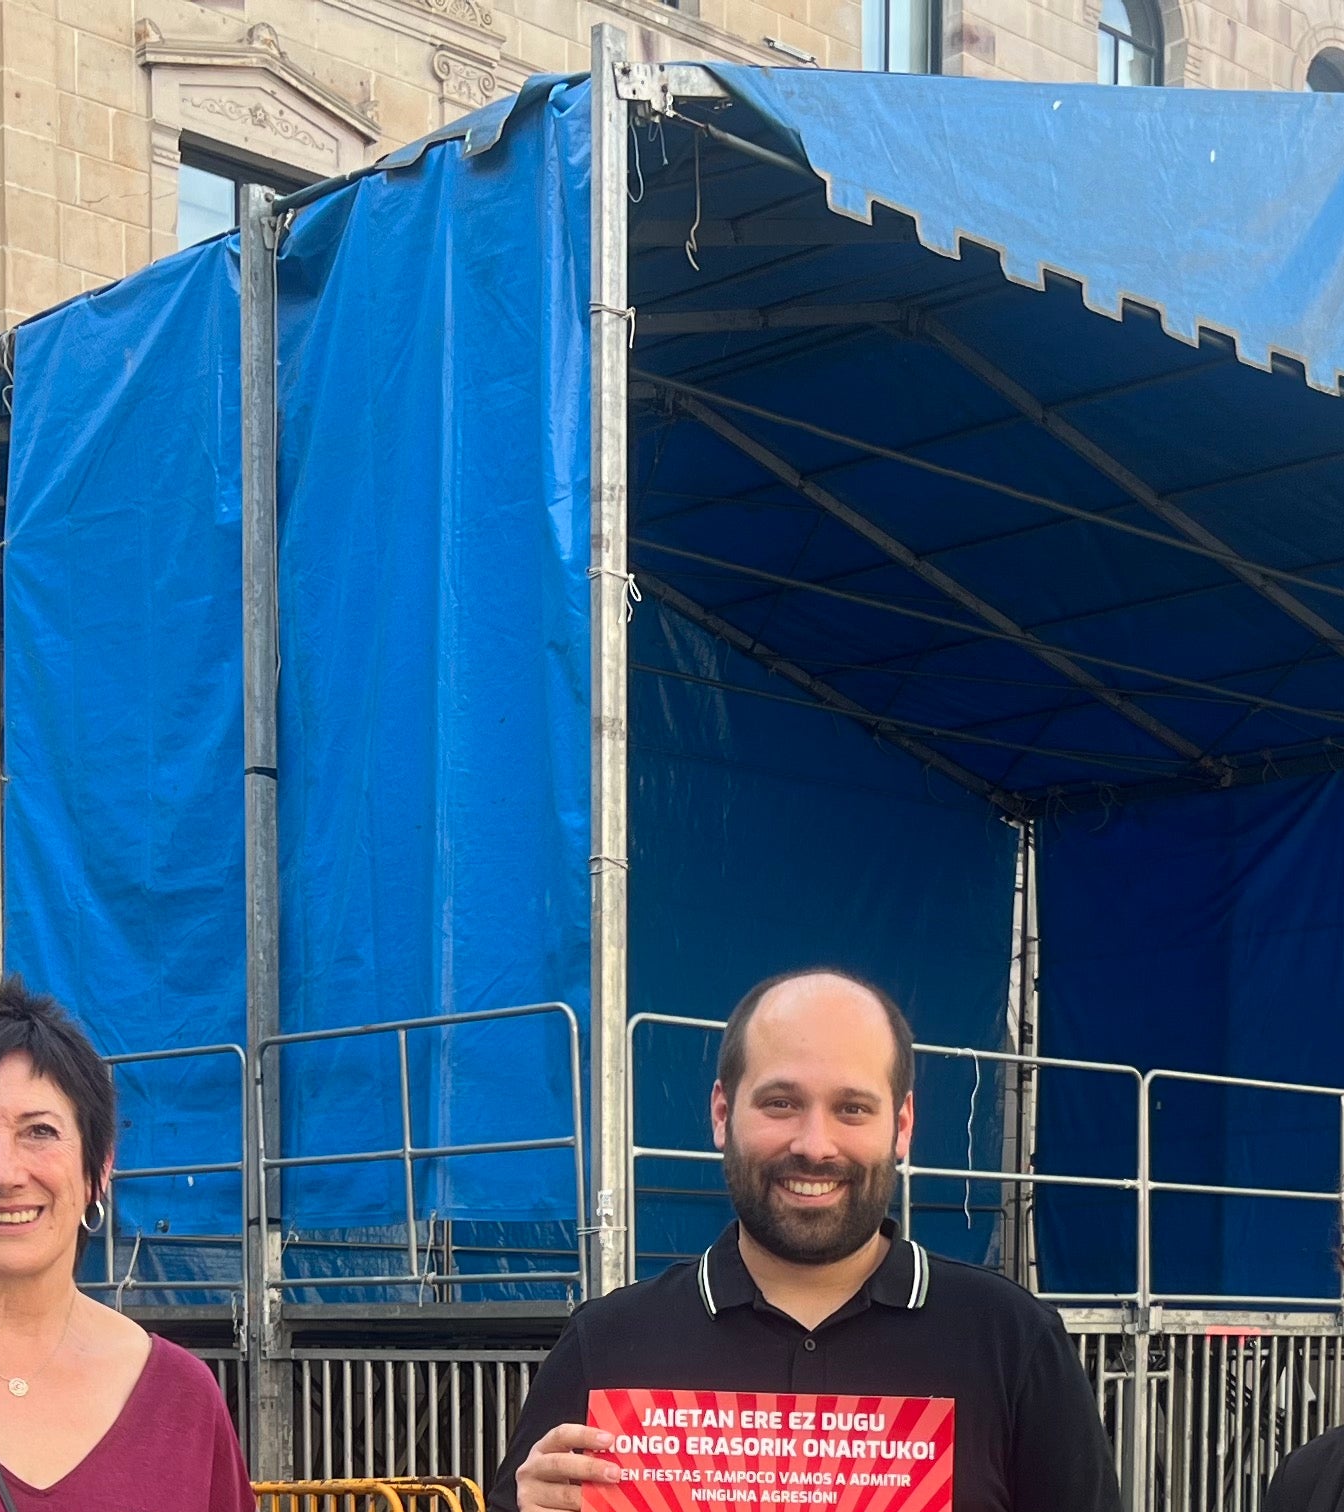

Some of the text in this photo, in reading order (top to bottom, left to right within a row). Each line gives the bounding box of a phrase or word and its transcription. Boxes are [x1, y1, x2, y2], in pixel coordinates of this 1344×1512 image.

[641, 1408, 885, 1432] JAIETAN ERE EZ DUGU
[593, 1435, 936, 1461] ONGO ERASORIK ONARTUKO!
[617, 1468, 911, 1488] EN FIESTAS TAMPOCO VAMOS A ADMITIR
[691, 1488, 838, 1504] NINGUNA AGRESIÓN!
